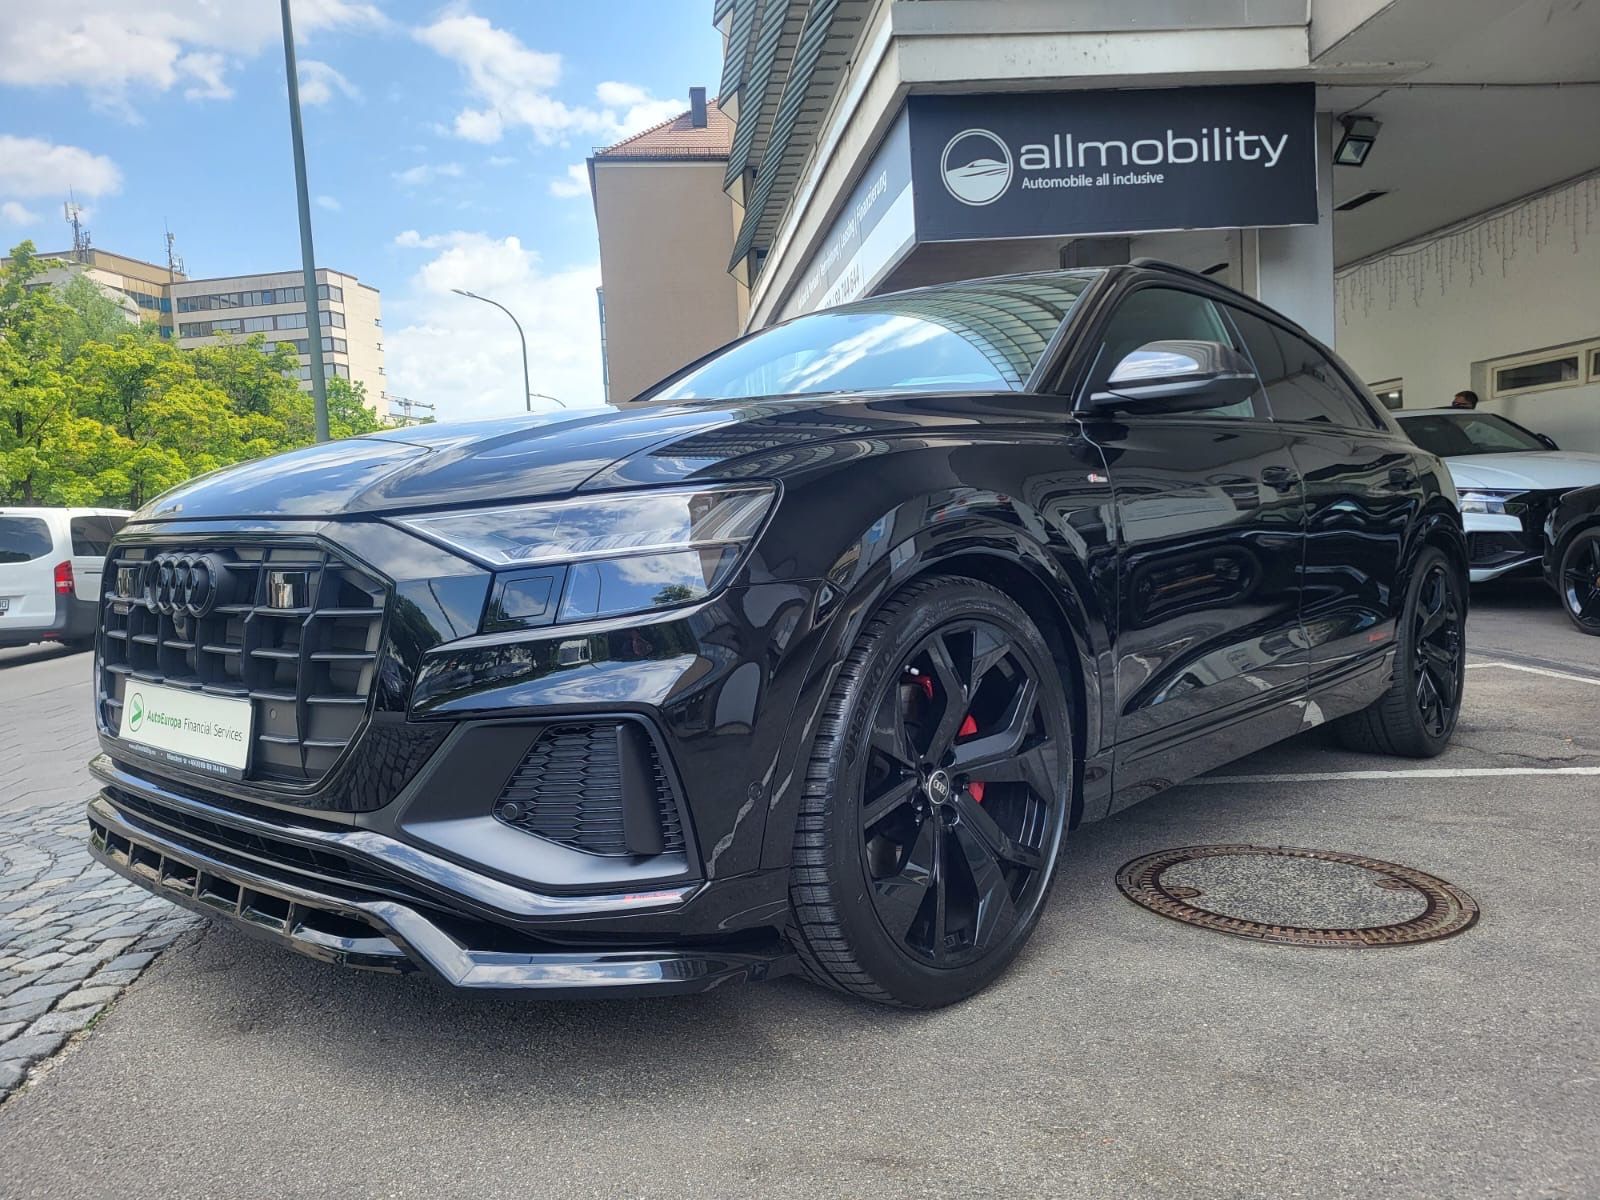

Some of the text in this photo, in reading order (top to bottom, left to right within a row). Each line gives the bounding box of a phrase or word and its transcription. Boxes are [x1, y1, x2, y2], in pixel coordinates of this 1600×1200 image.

[1019, 127, 1289, 170] allmobility
[856, 169, 887, 222] Finanzierung
[1021, 171, 1164, 190] Automobile all inclusive
[146, 710, 243, 742] AutoEuropa Financial Services
